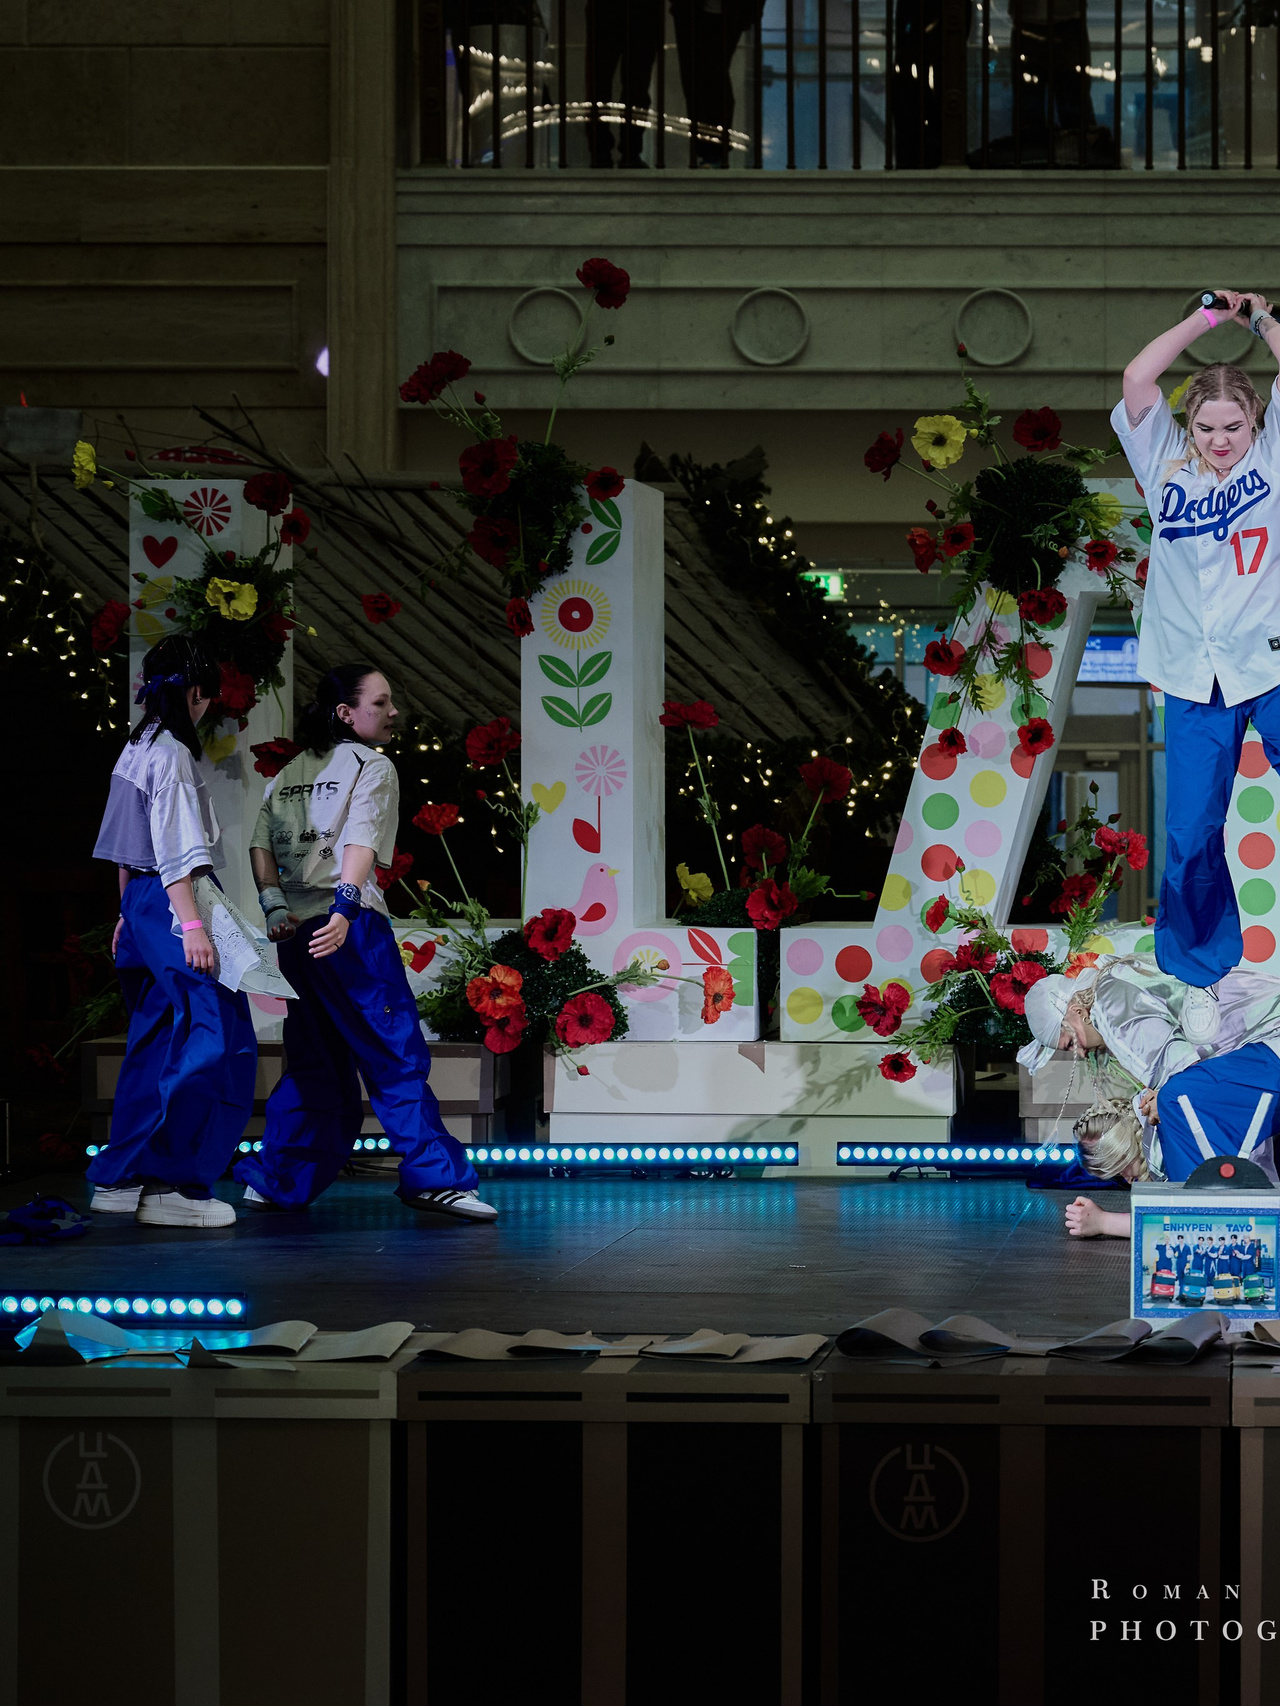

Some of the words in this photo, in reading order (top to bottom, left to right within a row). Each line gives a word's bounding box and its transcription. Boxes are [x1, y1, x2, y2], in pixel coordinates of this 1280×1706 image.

[1159, 468, 1271, 543] Dodgers
[1230, 526, 1269, 576] 17
[1163, 1223, 1213, 1232] ENHYPEN
[1226, 1223, 1253, 1232] TAYO
